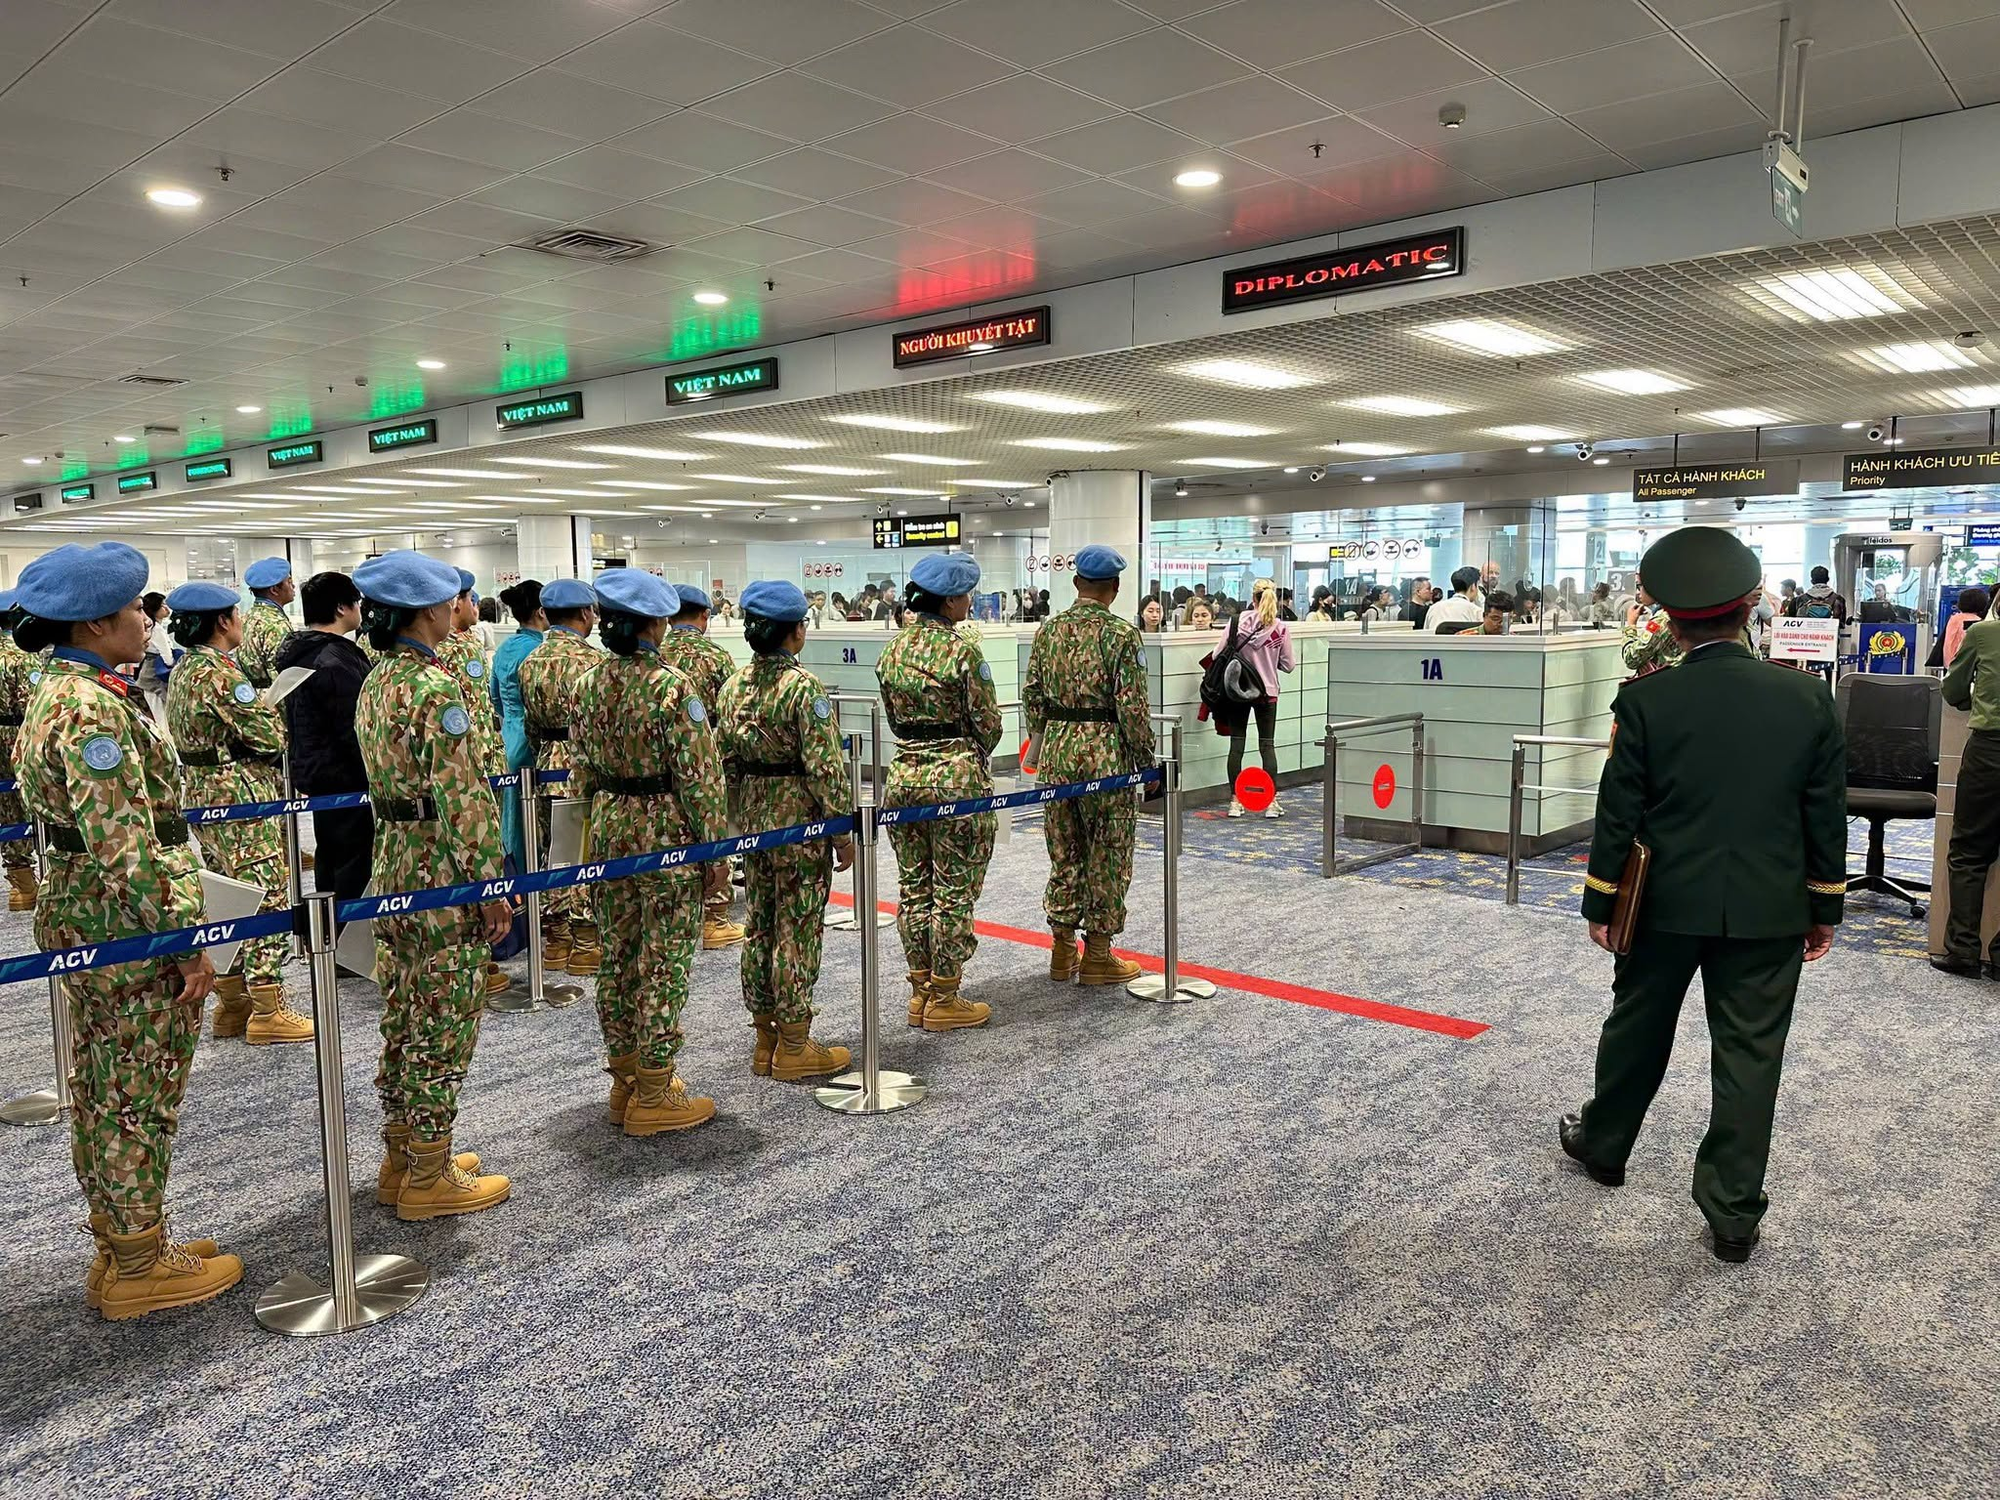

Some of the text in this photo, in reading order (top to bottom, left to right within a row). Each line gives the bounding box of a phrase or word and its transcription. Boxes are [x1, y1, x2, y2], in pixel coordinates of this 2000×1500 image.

[1235, 245, 1448, 296] DIPLOMATIC
[900, 332, 943, 355] NGƯỜI
[1006, 318, 1036, 338] TẬT
[674, 368, 761, 394] VIỆT NAM
[503, 401, 569, 422] VIỆT NAM
[399, 427, 425, 440] NAM
[292, 445, 313, 457] NAM
[1851, 460, 1890, 473] HÀNH
[1894, 456, 1945, 470] KHÁCH
[1949, 455, 1972, 467] ƯU
[1663, 471, 1680, 484] CẢ
[1683, 469, 1718, 482] HÀNH
[1721, 468, 1765, 481] KHÁCH
[1850, 475, 1886, 487] Priority
[1638, 487, 1697, 497] All Passenger
[842, 647, 857, 663] 3A
[1420, 658, 1443, 680] 1A
[497, 775, 519, 786] ACV
[1128, 773, 1142, 783] ACV
[1085, 780, 1101, 792] ACV
[1040, 789, 1056, 800] ACV
[283, 800, 310, 812] ACV
[937, 804, 956, 816] ACV
[990, 797, 1009, 808] ACV
[201, 808, 230, 820] ACV
[879, 810, 900, 823] ACV
[803, 823, 825, 837] ACV
[735, 836, 760, 851] ACV
[660, 850, 687, 866] ACV
[576, 864, 606, 881] ACV
[482, 879, 515, 897] ACV
[376, 895, 414, 914] ACV
[192, 924, 236, 945] ACV
[48, 948, 98, 971] ACV
